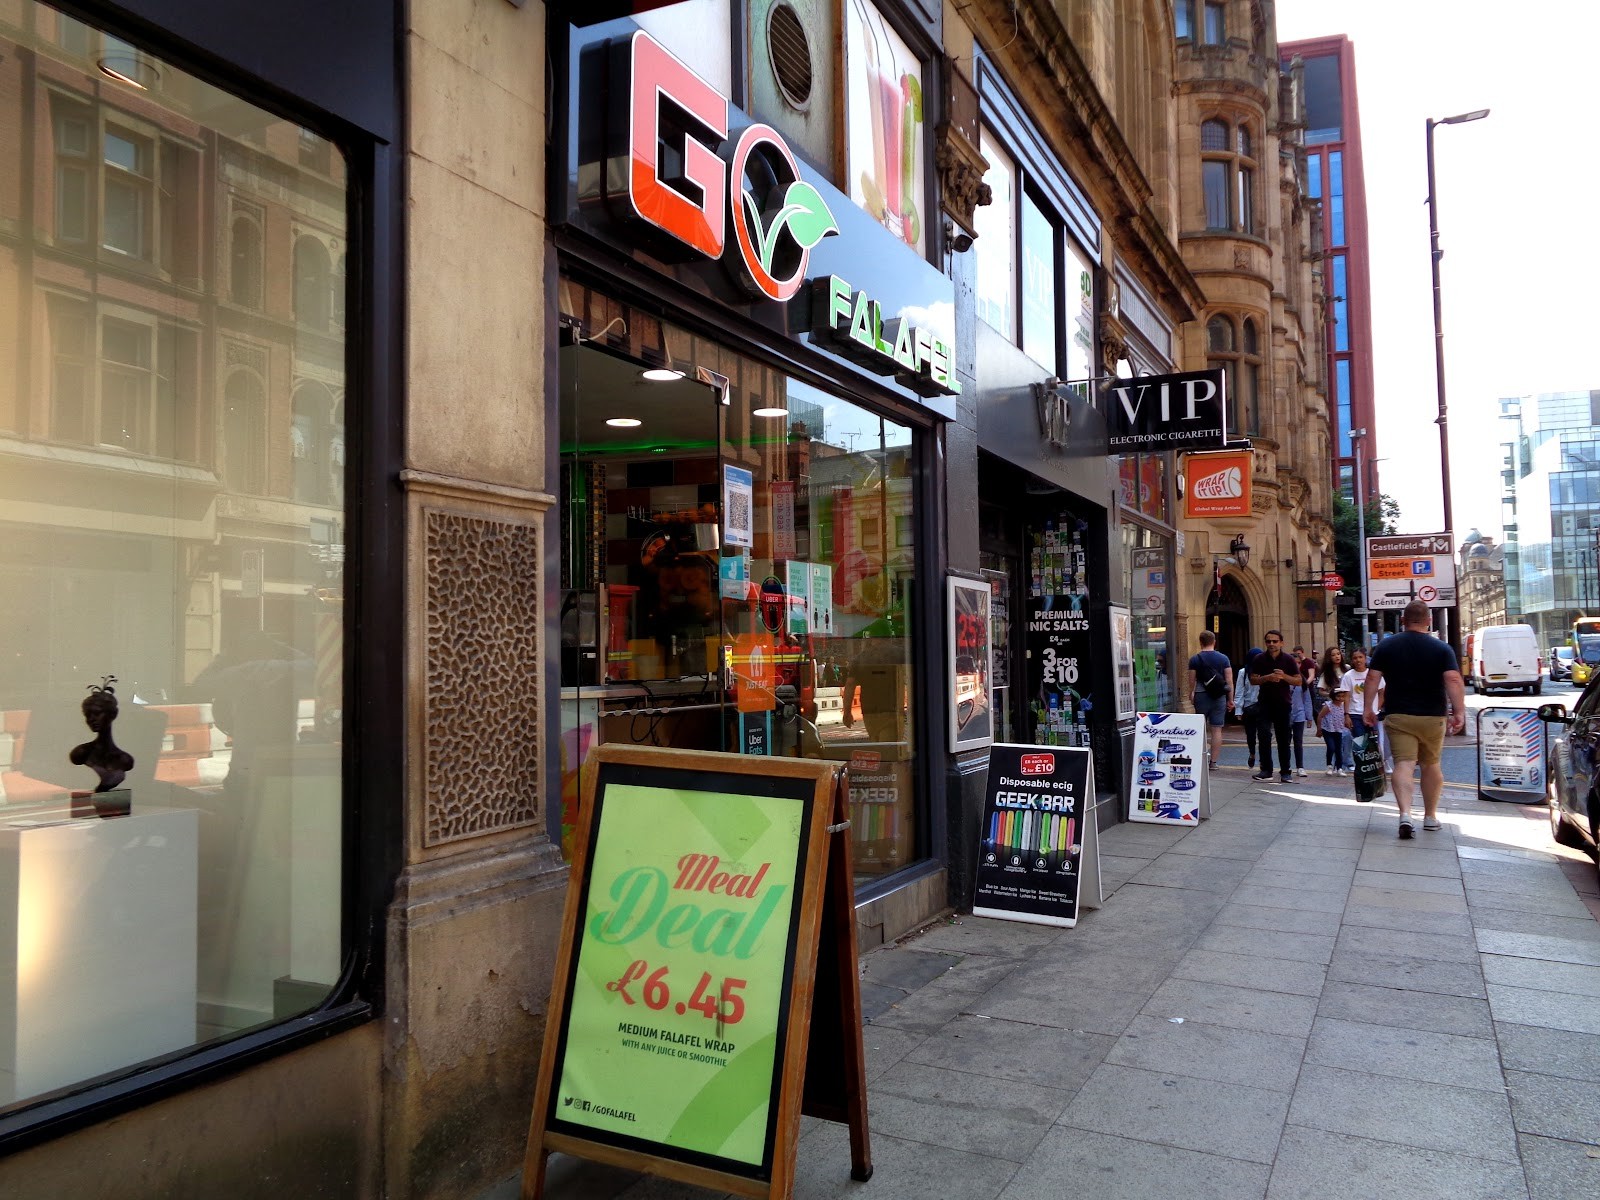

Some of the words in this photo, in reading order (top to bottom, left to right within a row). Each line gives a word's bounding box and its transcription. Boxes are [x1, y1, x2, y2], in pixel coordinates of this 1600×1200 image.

[629, 30, 838, 301] GO
[829, 274, 962, 395] FALAFEL
[1112, 379, 1217, 425] VIP
[1110, 432, 1167, 445] ELECTRONIC
[1168, 428, 1222, 440] CIGARETTE
[1198, 472, 1226, 488] WRAP
[1198, 487, 1207, 497] IT
[1209, 480, 1229, 496] UP!
[1371, 542, 1418, 551] Castlefield
[1373, 561, 1409, 569] Gartside
[1373, 598, 1406, 606] Central
[1034, 610, 1084, 620] PREMIUM
[1029, 621, 1051, 631] NIC
[1053, 620, 1090, 631] SALTS
[1042, 647, 1057, 667] 3
[1057, 657, 1078, 666] FOR
[1042, 665, 1079, 684] £10
[746, 681, 758, 690] JUST
[1141, 724, 1197, 738] Signature
[748, 735, 763, 745] Uber
[748, 746, 763, 755] Eats
[1034, 763, 1053, 773] £10
[1000, 776, 1051, 789] Disposable
[1052, 781, 1073, 791] ecig
[995, 791, 1039, 810] GEEK
[1040, 794, 1075, 813] BAR
[673, 853, 772, 899] Meal
[590, 866, 788, 960] Deal
[606, 959, 748, 1025] £6.45
[618, 1022, 658, 1039] MEDIUM
[660, 1030, 701, 1048] FALAFEL
[704, 1038, 735, 1054] WRAP
[621, 1038, 640, 1050] WITH
[641, 1042, 656, 1052] ANY
[656, 1046, 675, 1057] JUICE
[677, 1050, 688, 1059] OR
[689, 1052, 727, 1067] SMOOTHIE
[591, 1104, 637, 1122] /GOFALAFEL
